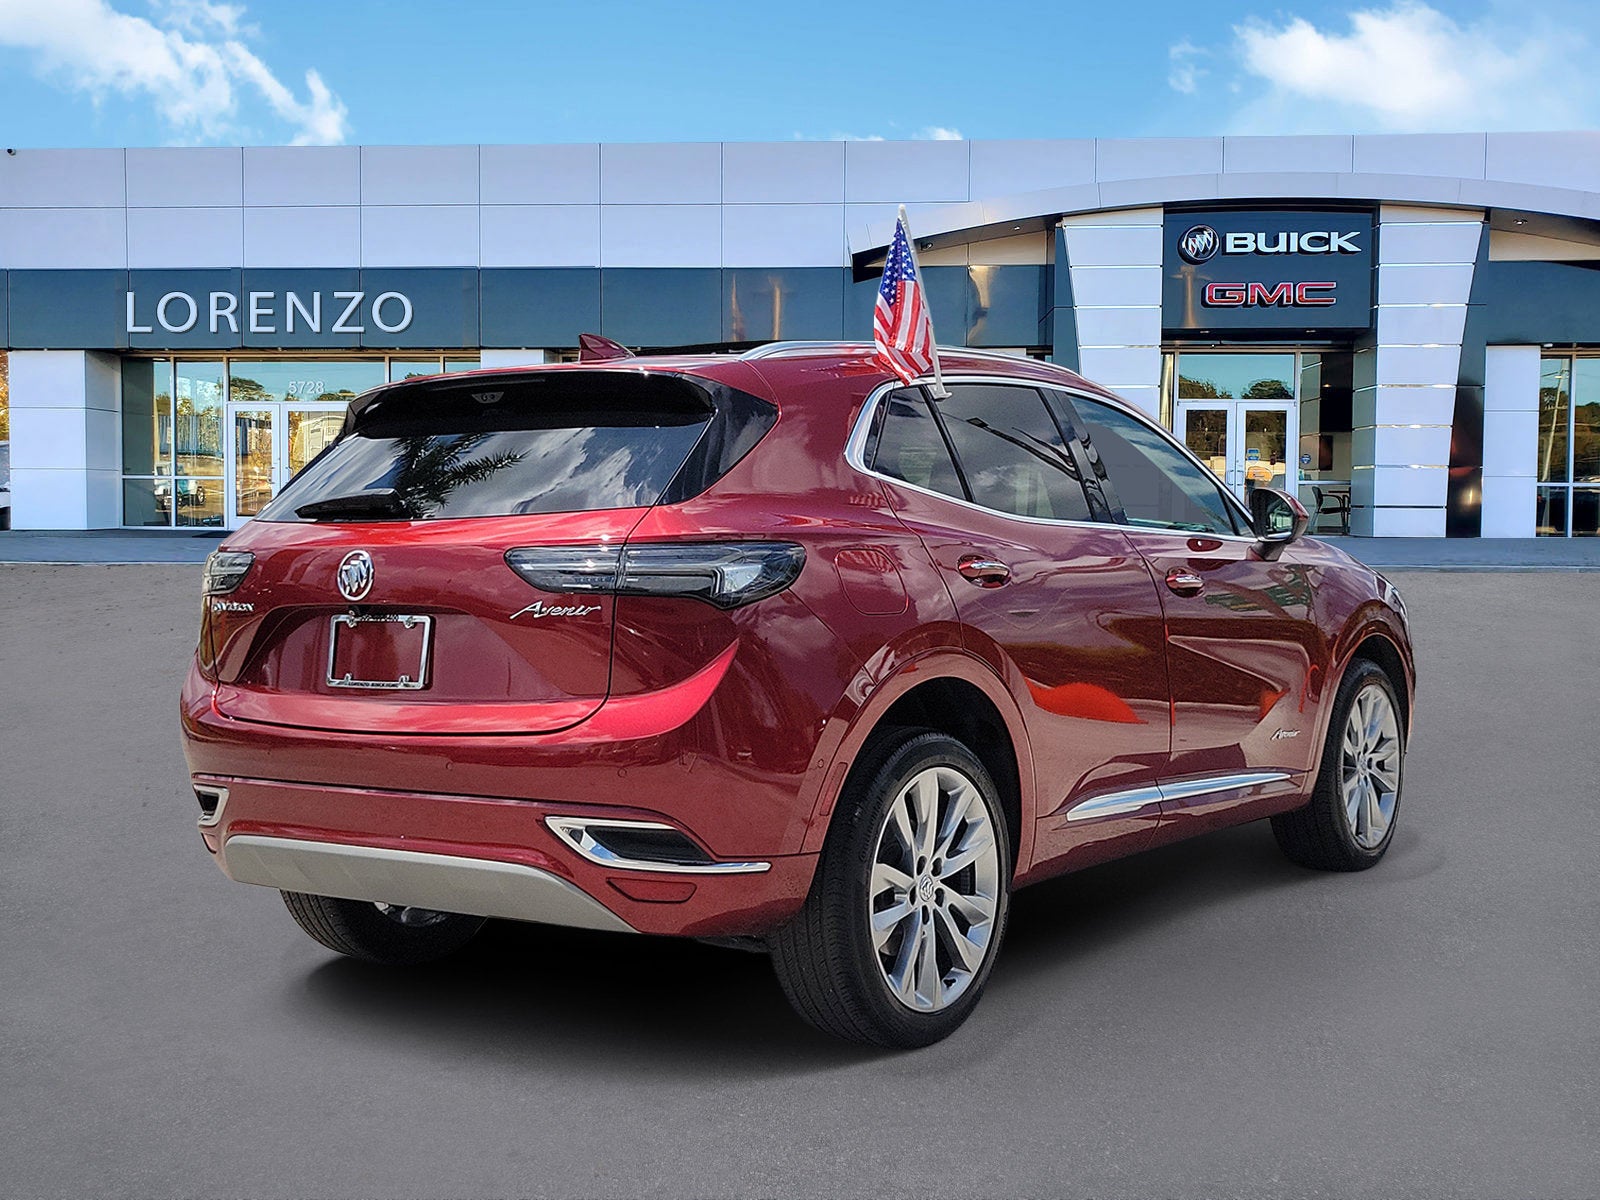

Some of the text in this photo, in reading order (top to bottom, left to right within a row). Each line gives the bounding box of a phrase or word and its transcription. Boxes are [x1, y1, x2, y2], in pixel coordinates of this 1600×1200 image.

[1226, 231, 1362, 253] BUICK
[1205, 282, 1337, 306] GMC
[126, 291, 413, 333] LORENZO
[288, 381, 325, 394] 5728
[509, 600, 602, 619] Avenir
